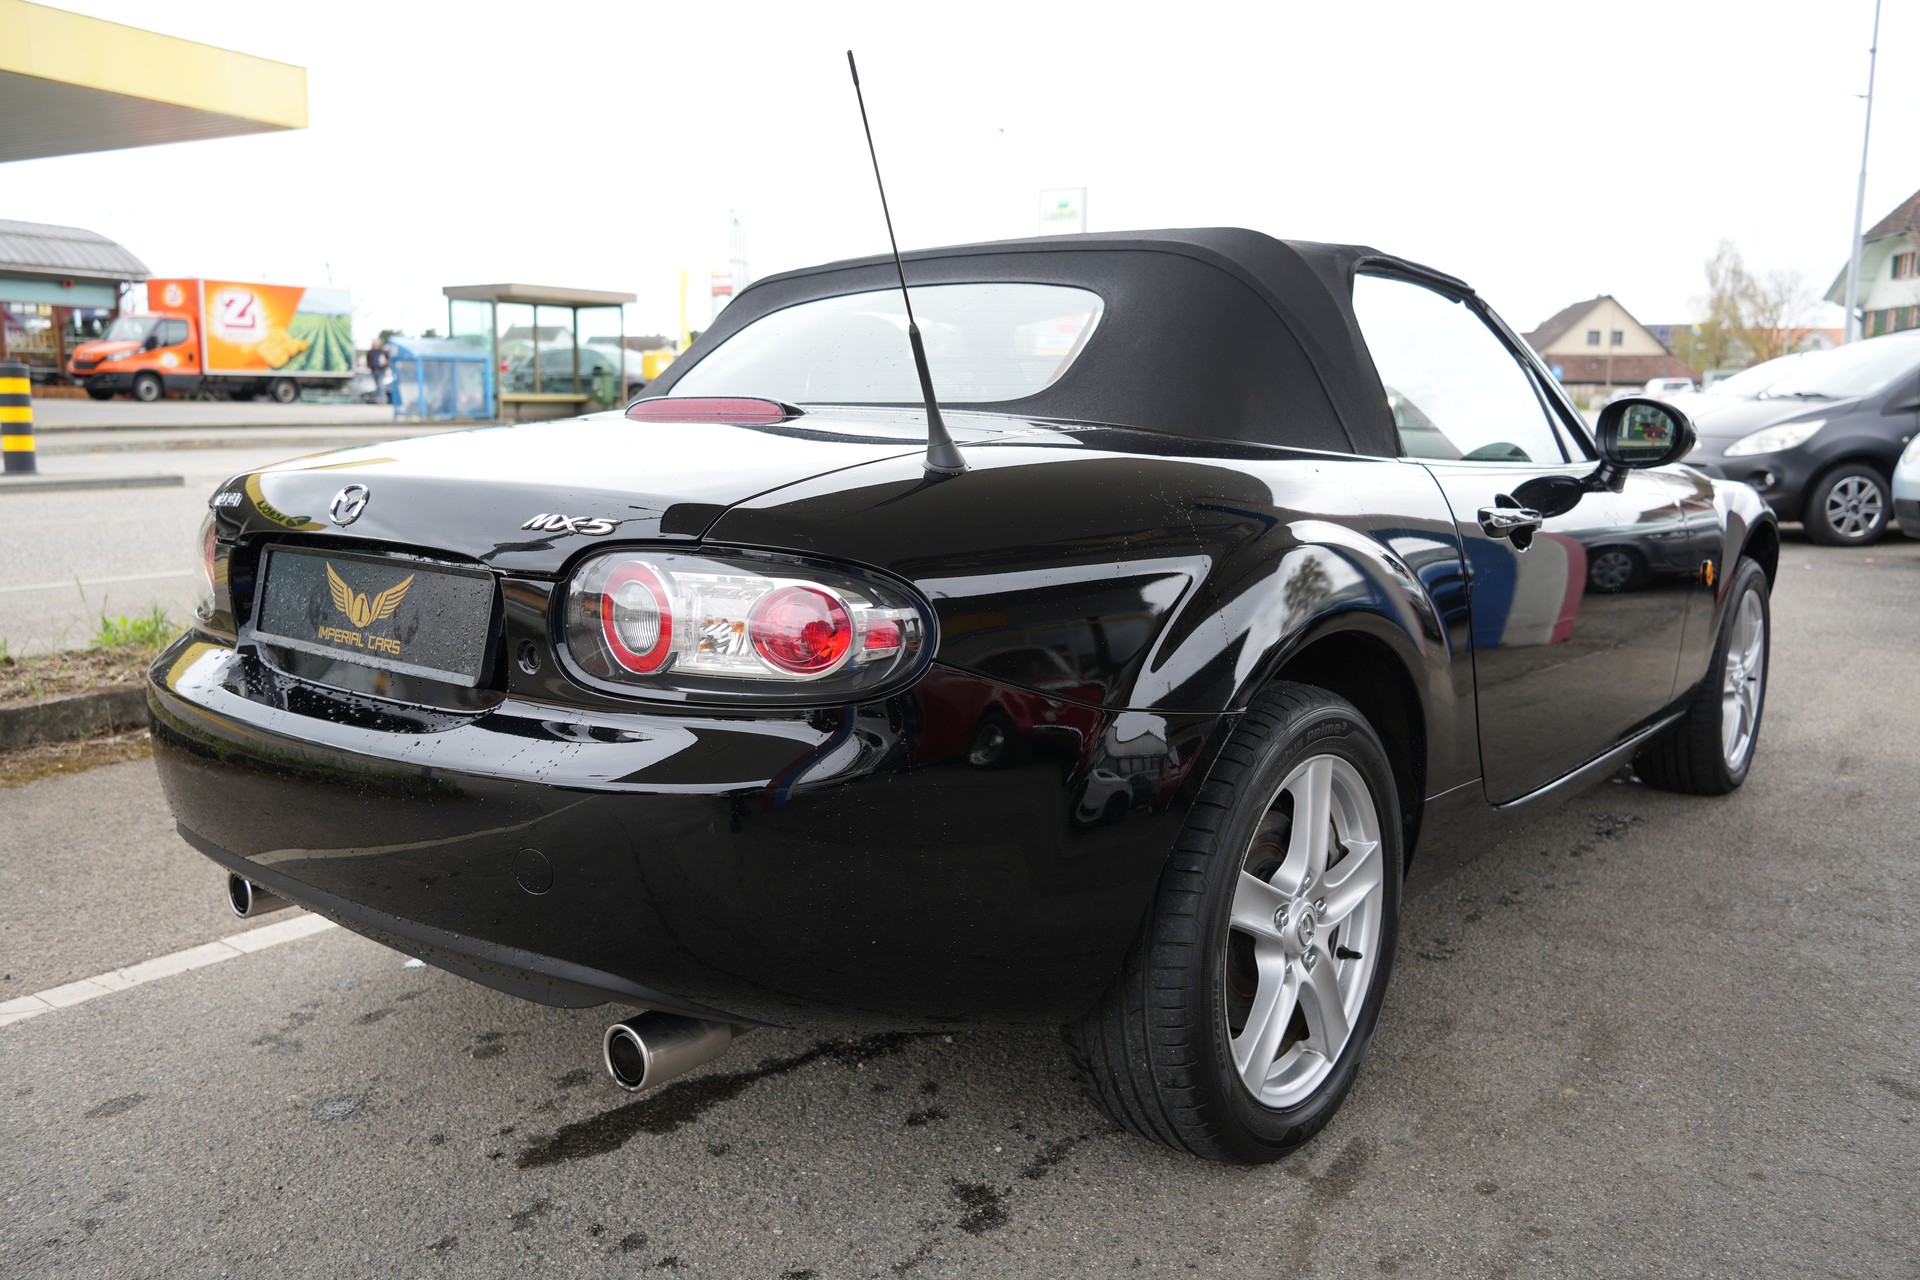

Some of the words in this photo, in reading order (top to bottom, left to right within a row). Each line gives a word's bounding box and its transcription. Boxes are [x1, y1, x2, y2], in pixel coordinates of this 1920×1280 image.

[221, 289, 256, 329] Z
[521, 513, 623, 536] MX-5
[318, 625, 364, 648] IMPERIAL
[367, 635, 401, 655] CARS
